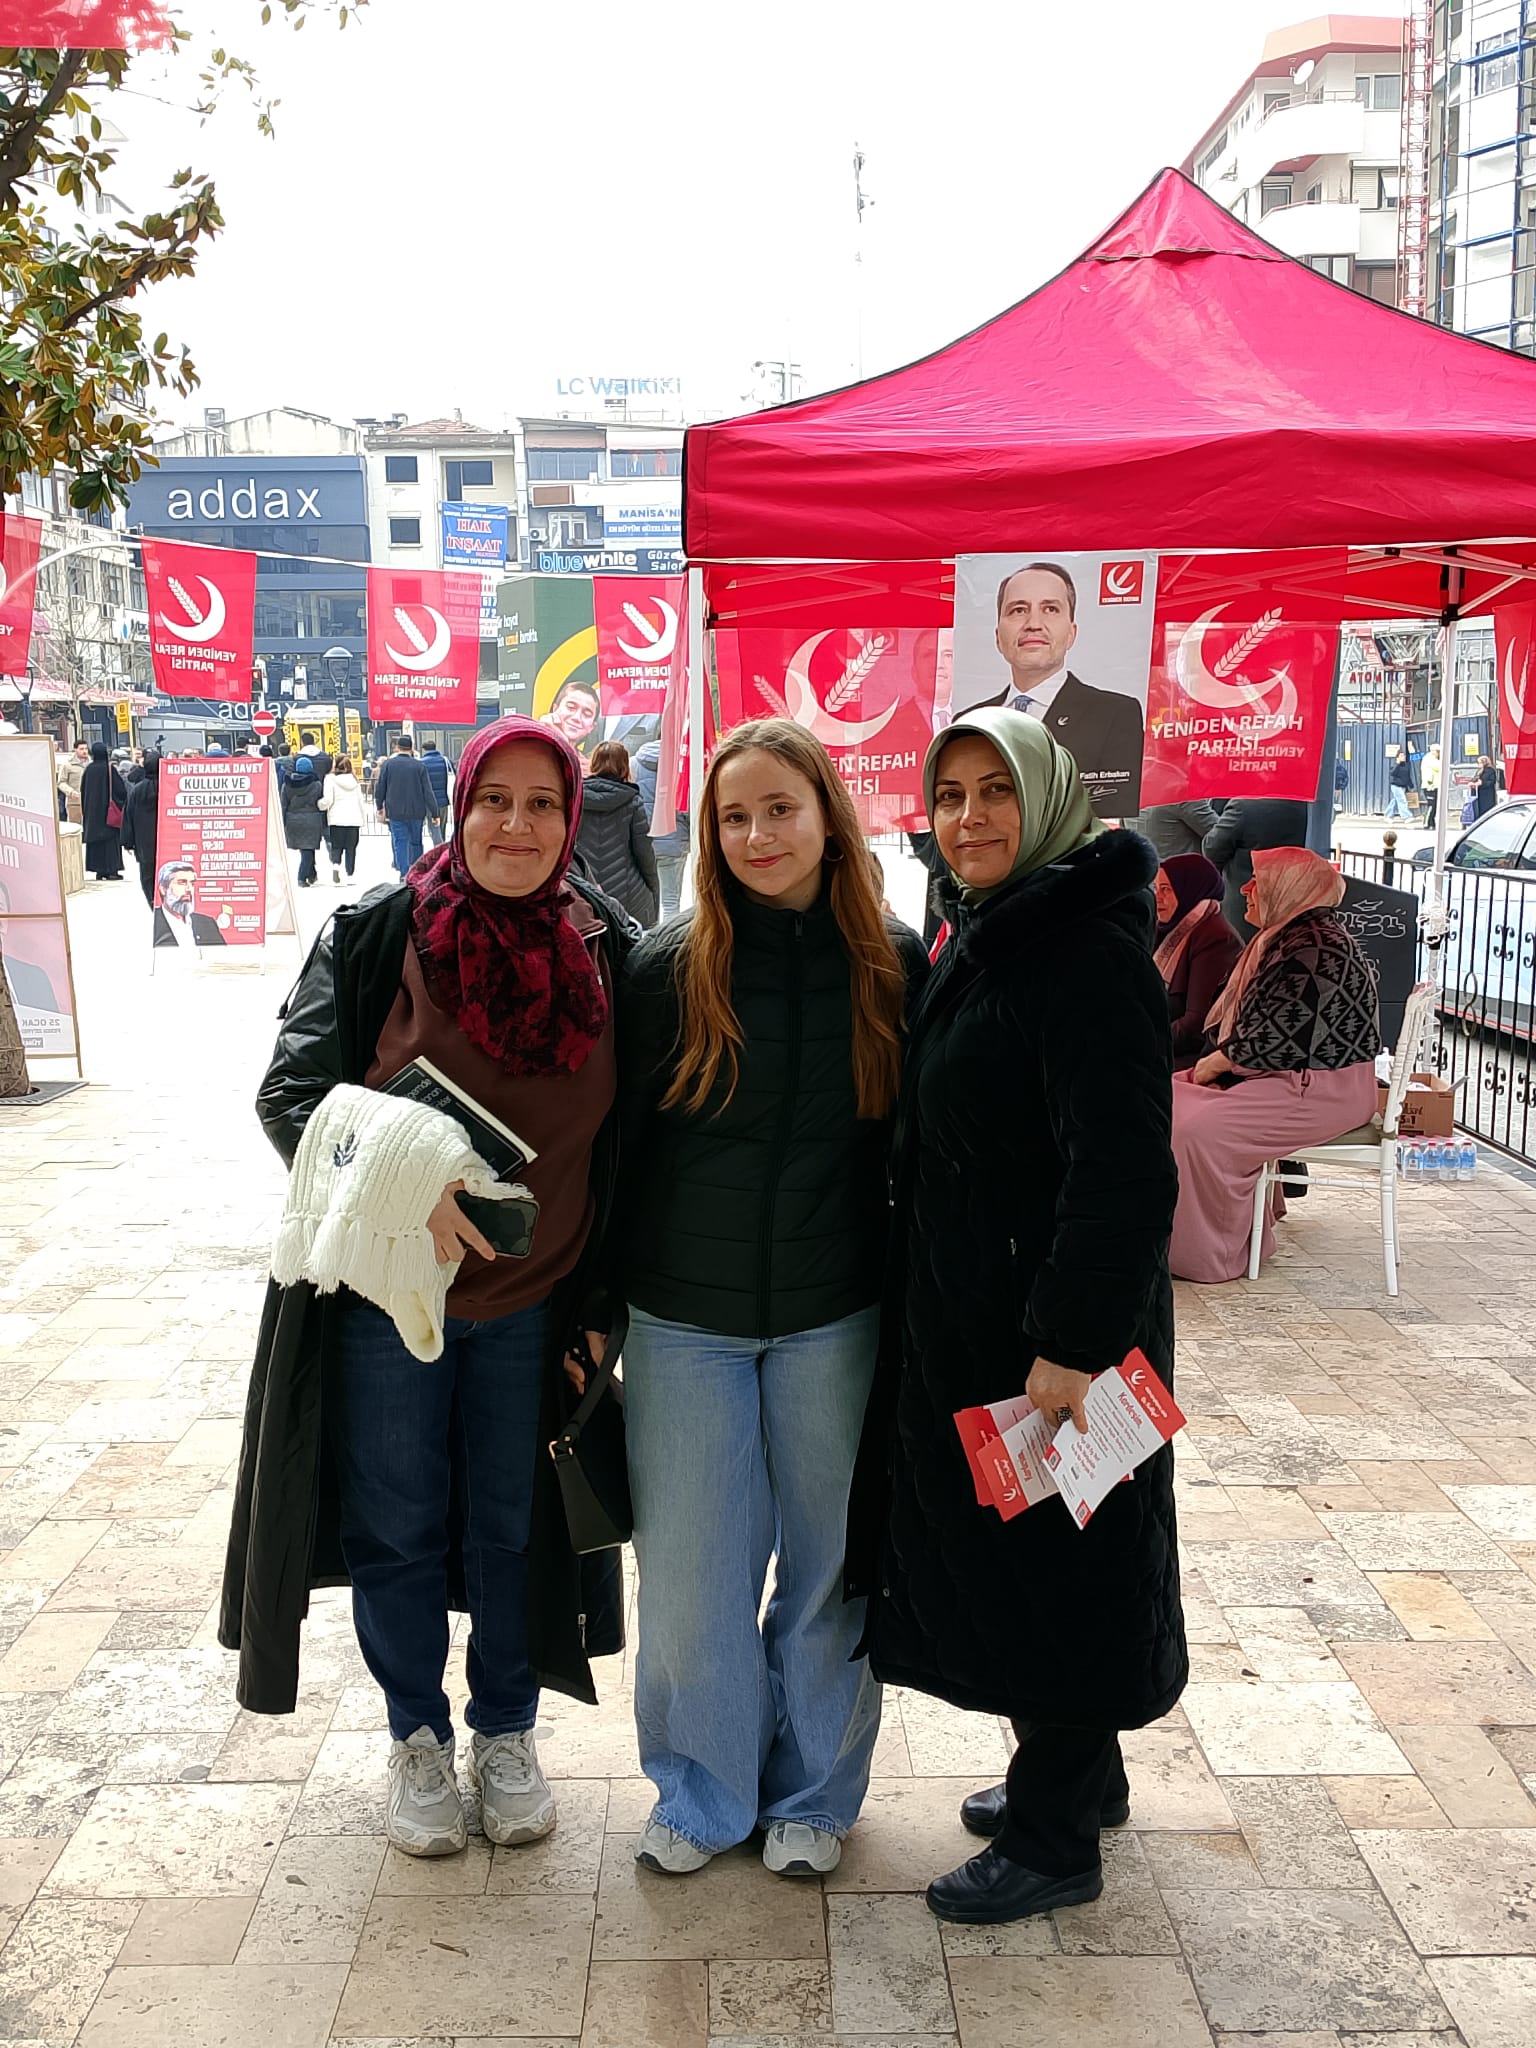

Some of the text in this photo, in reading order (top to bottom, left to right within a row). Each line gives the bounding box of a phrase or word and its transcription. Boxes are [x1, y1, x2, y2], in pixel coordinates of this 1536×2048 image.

[557, 378, 585, 395] LC
[167, 478, 322, 519] addax
[457, 518, 493, 534] HAK
[446, 533, 502, 554] İNŞAAT
[539, 551, 638, 573] bluewhite
[1151, 714, 1304, 740] YENİDEN REFAH
[1187, 733, 1260, 756] PARTİSİ
[167, 762, 264, 775] KONFERANSA DAVET
[858, 751, 917, 773] REFAH
[184, 777, 246, 790] KULLUK VE
[846, 775, 880, 795] TİSİ
[182, 792, 248, 806] TESLİMİYET
